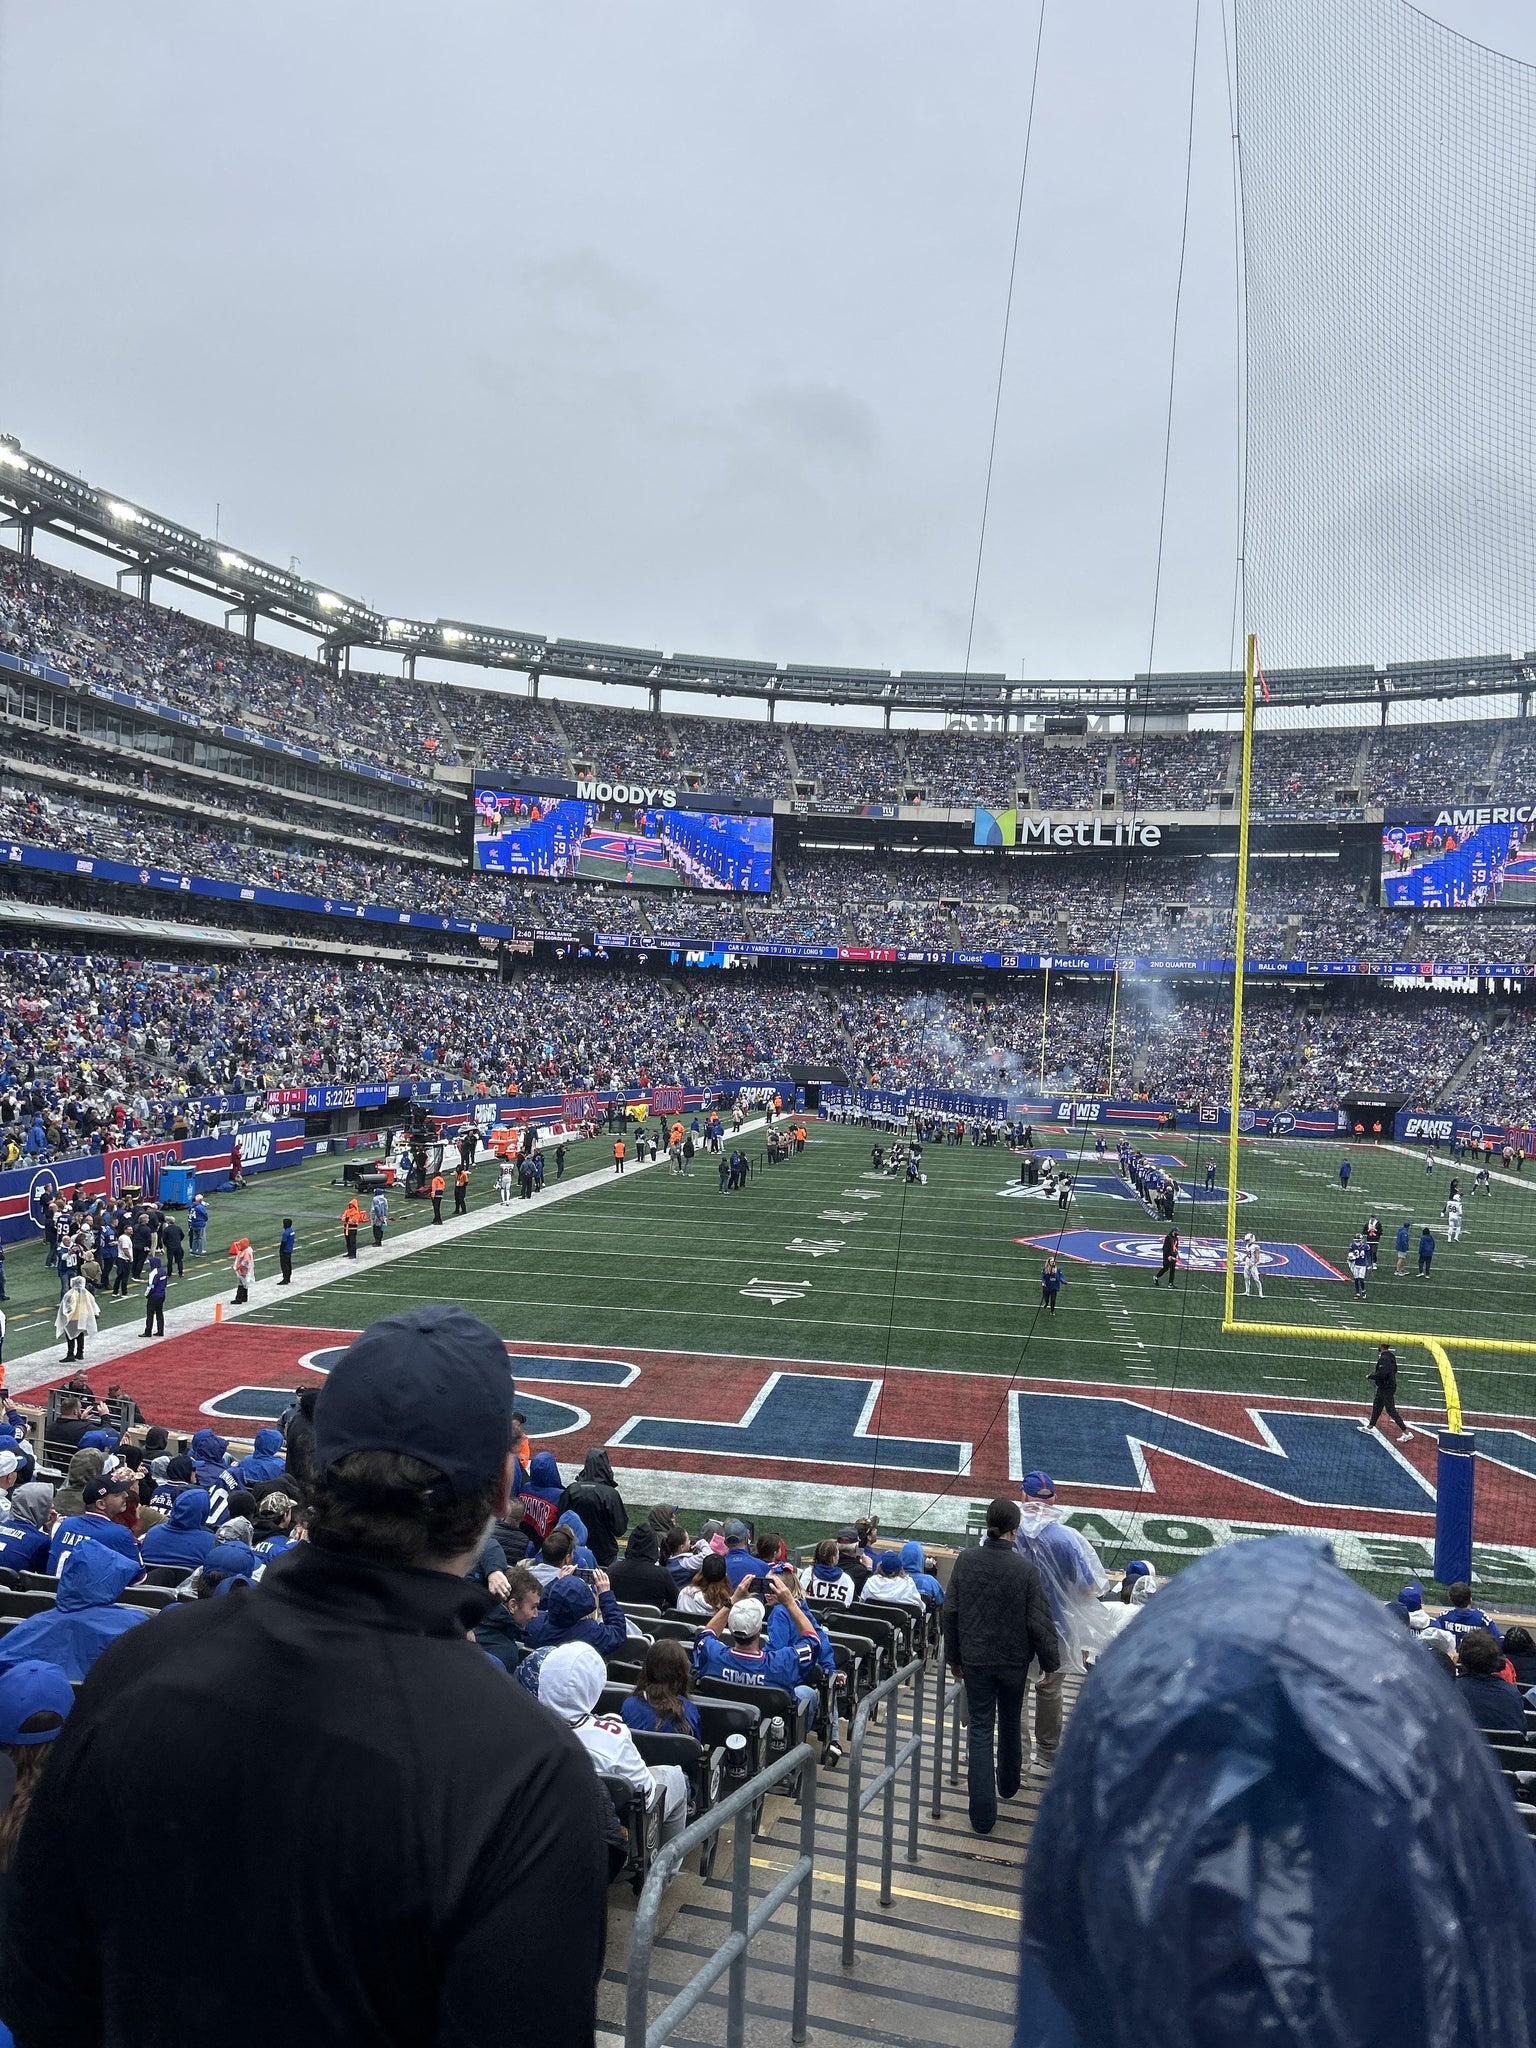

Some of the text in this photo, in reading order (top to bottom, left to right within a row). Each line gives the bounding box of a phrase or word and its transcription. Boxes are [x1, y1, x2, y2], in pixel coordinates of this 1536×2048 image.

[1021, 816, 1162, 847] MetLife
[517, 930, 531, 938] 2:40
[870, 951, 881, 959] 17
[926, 953, 938, 962] 19
[959, 954, 983, 963] Quest
[1003, 957, 1016, 966] 25
[1054, 958, 1090, 968] MetLife
[1113, 959, 1135, 970] 5:22
[1384, 965, 1393, 973] 13
[283, 1091, 290, 1101] 17
[308, 1094, 317, 1106] 2Q
[325, 1089, 343, 1106] 5:22
[344, 1089, 355, 1105] 25
[654, 1089, 683, 1112] GIANTS
[282, 1103, 290, 1113] 19
[1202, 1109, 1215, 1120] 25
[1406, 1118, 1453, 1136] GIANTS
[57, 1223, 70, 1235] 89
[1354, 1249, 1365, 1259] 34
[66, 1253, 78, 1267] 80
[739, 1277, 814, 1299] 10
[1444, 1621, 1455, 1631] THE
[722, 1667, 765, 1686] SIMMS
